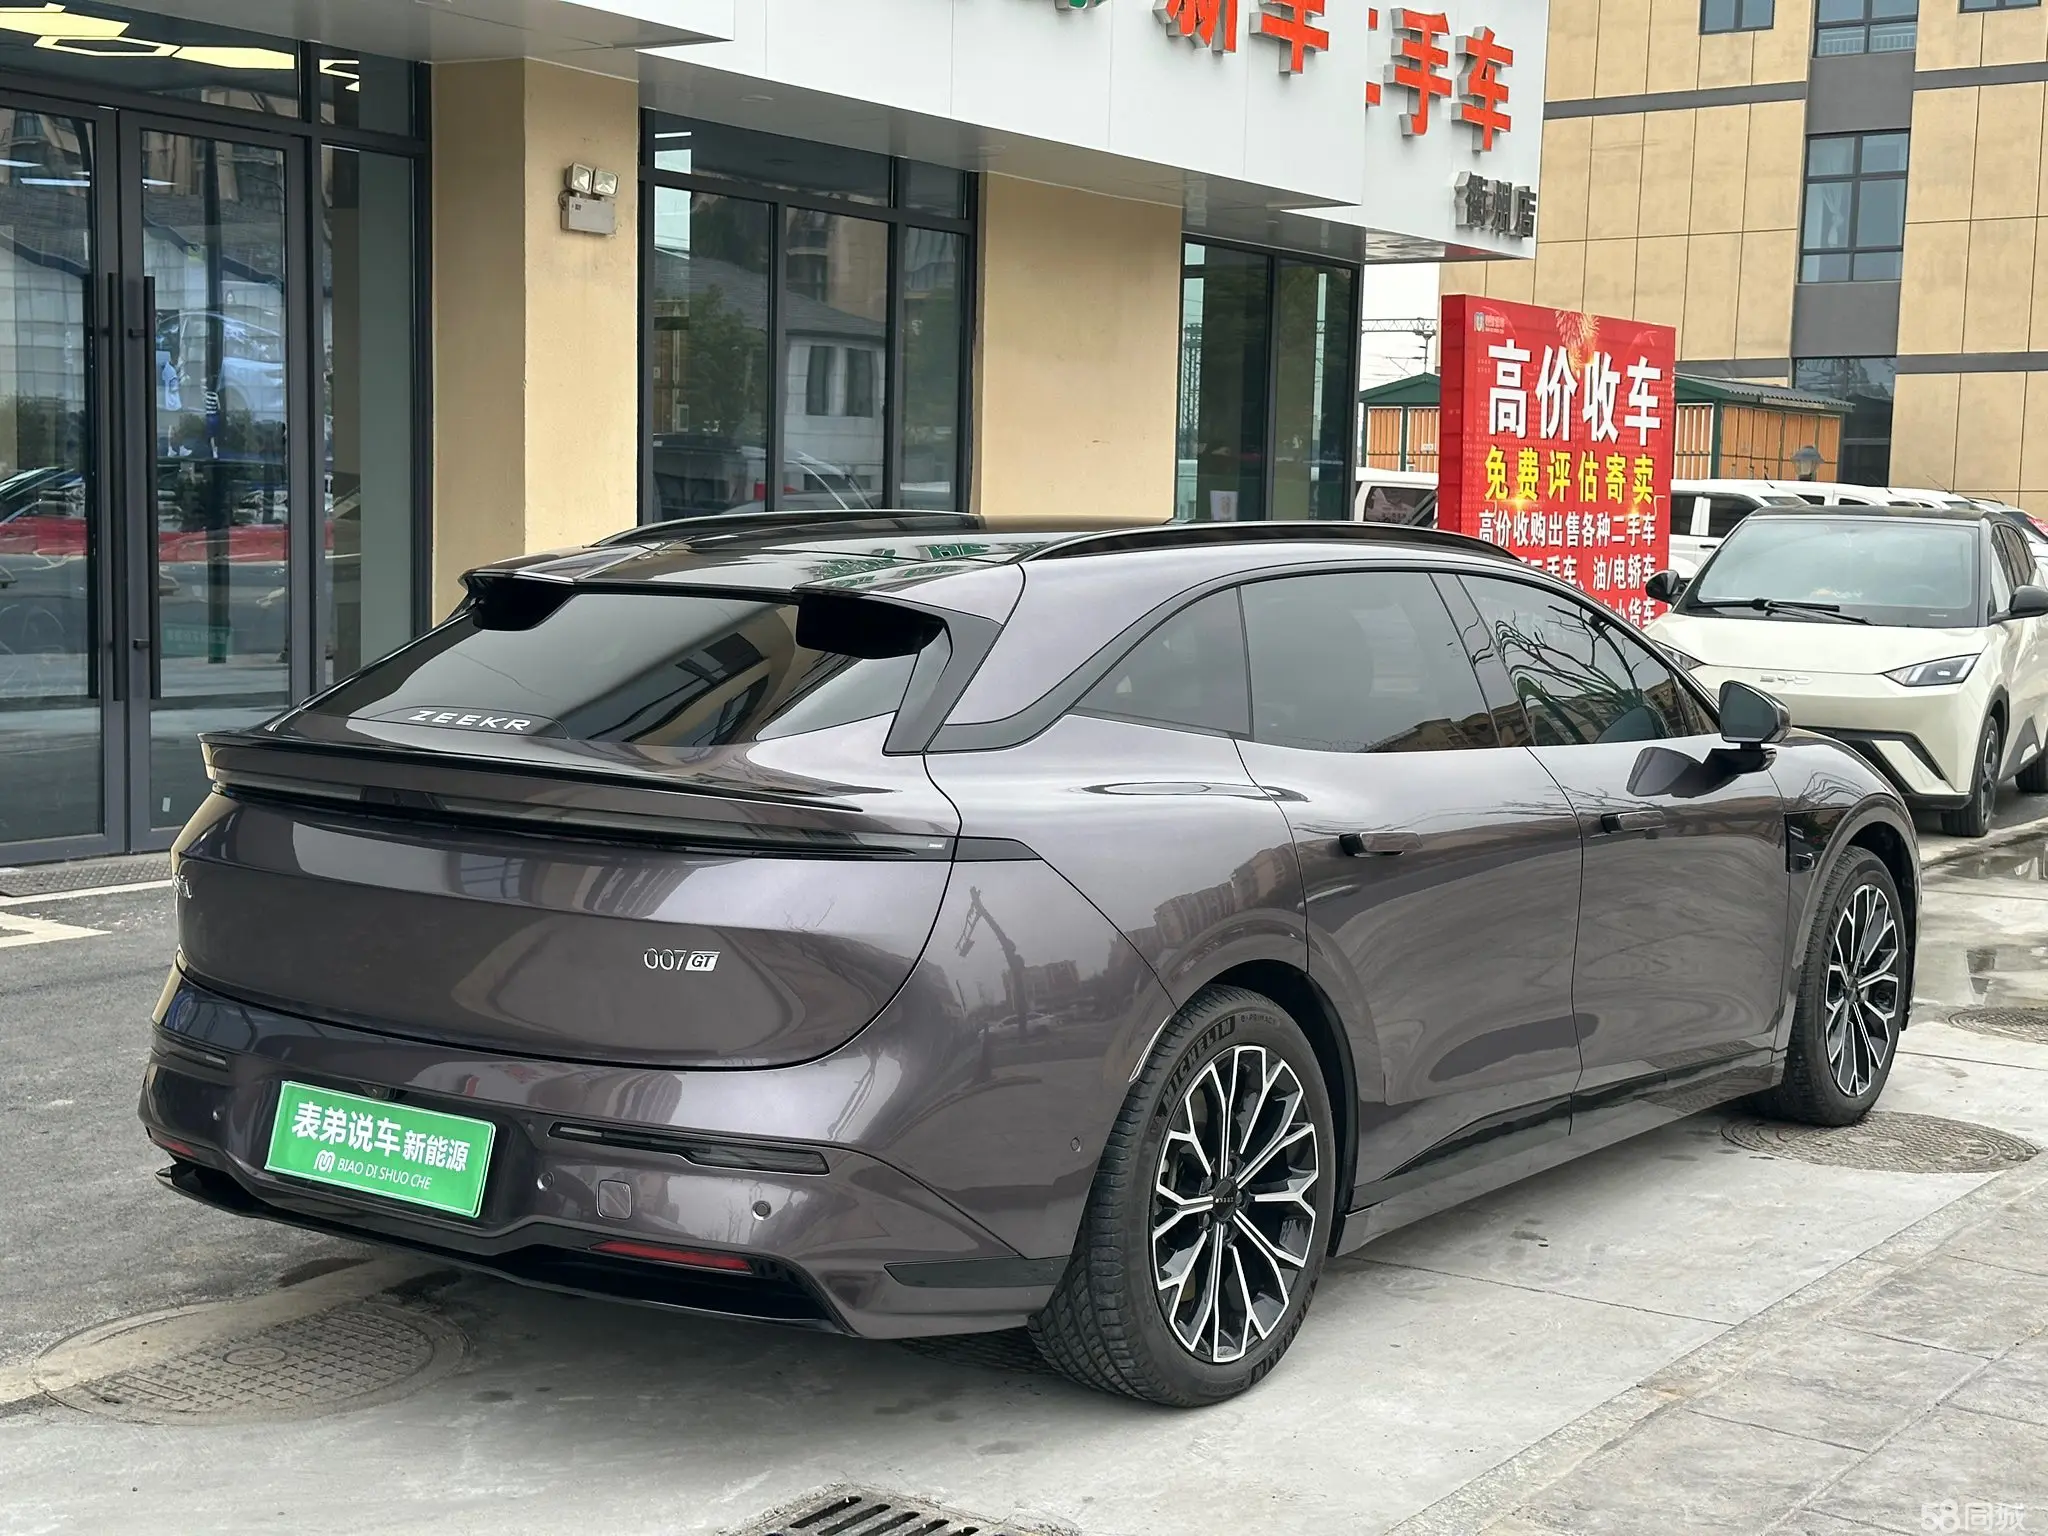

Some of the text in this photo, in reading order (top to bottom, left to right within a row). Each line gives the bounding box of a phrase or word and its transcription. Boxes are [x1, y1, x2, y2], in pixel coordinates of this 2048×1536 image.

[1488, 338, 1662, 446] 高价收车
[1484, 444, 1656, 505] 免费评估寄卖
[1479, 508, 1656, 548] 高价收购出售各种二手车
[1759, 673, 1813, 686] BYD
[408, 710, 531, 731] ZEEKR
[644, 947, 717, 971] 007 GT
[337, 1157, 433, 1190] BIAO DI SHUO CHE
